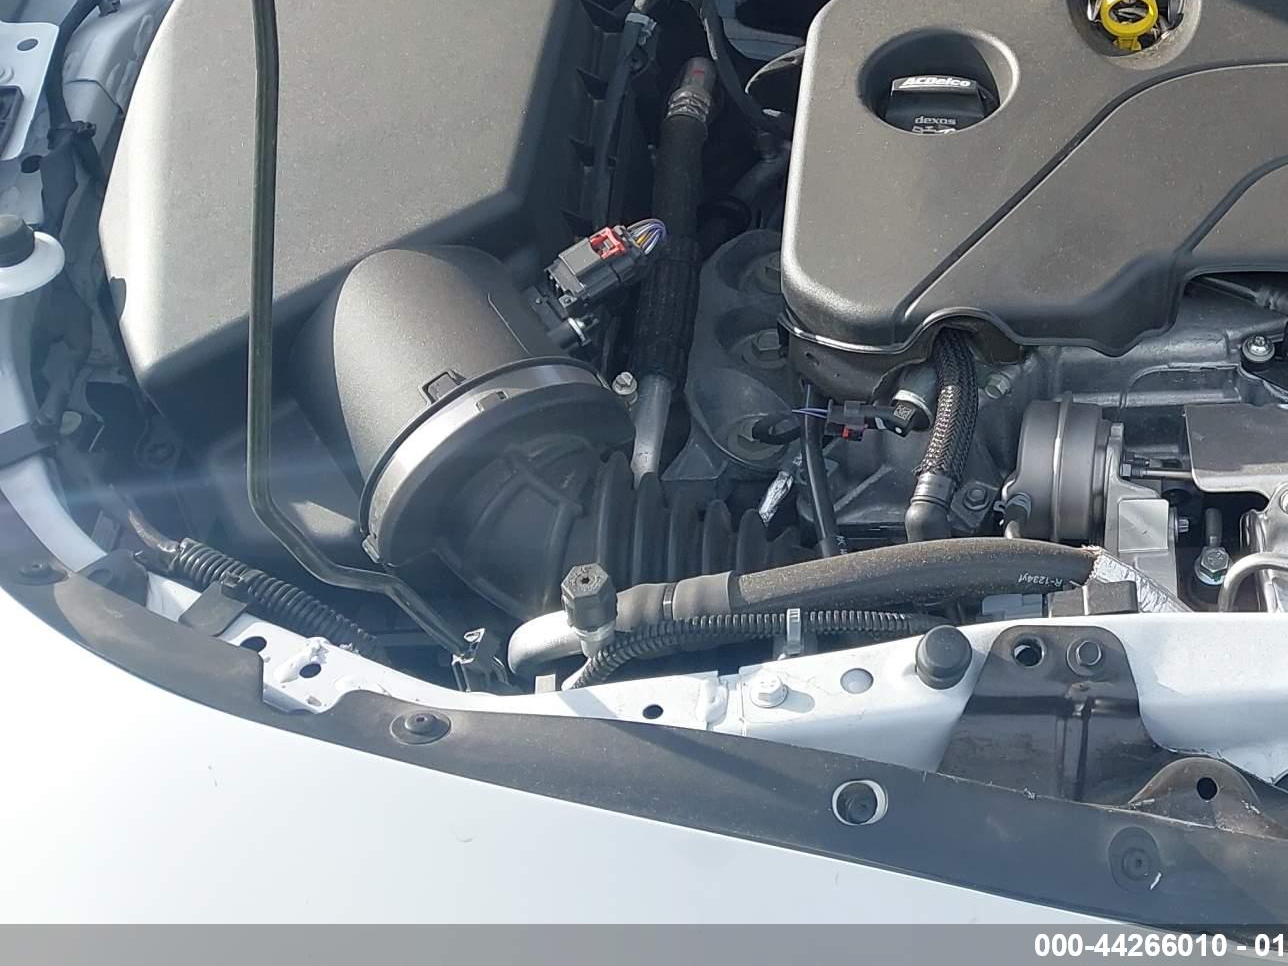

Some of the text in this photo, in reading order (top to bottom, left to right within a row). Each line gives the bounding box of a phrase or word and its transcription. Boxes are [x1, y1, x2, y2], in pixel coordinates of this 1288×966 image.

[900, 77, 972, 88] ACDelco
[914, 115, 957, 125] dexos
[1017, 572, 1063, 587] R-1234yf
